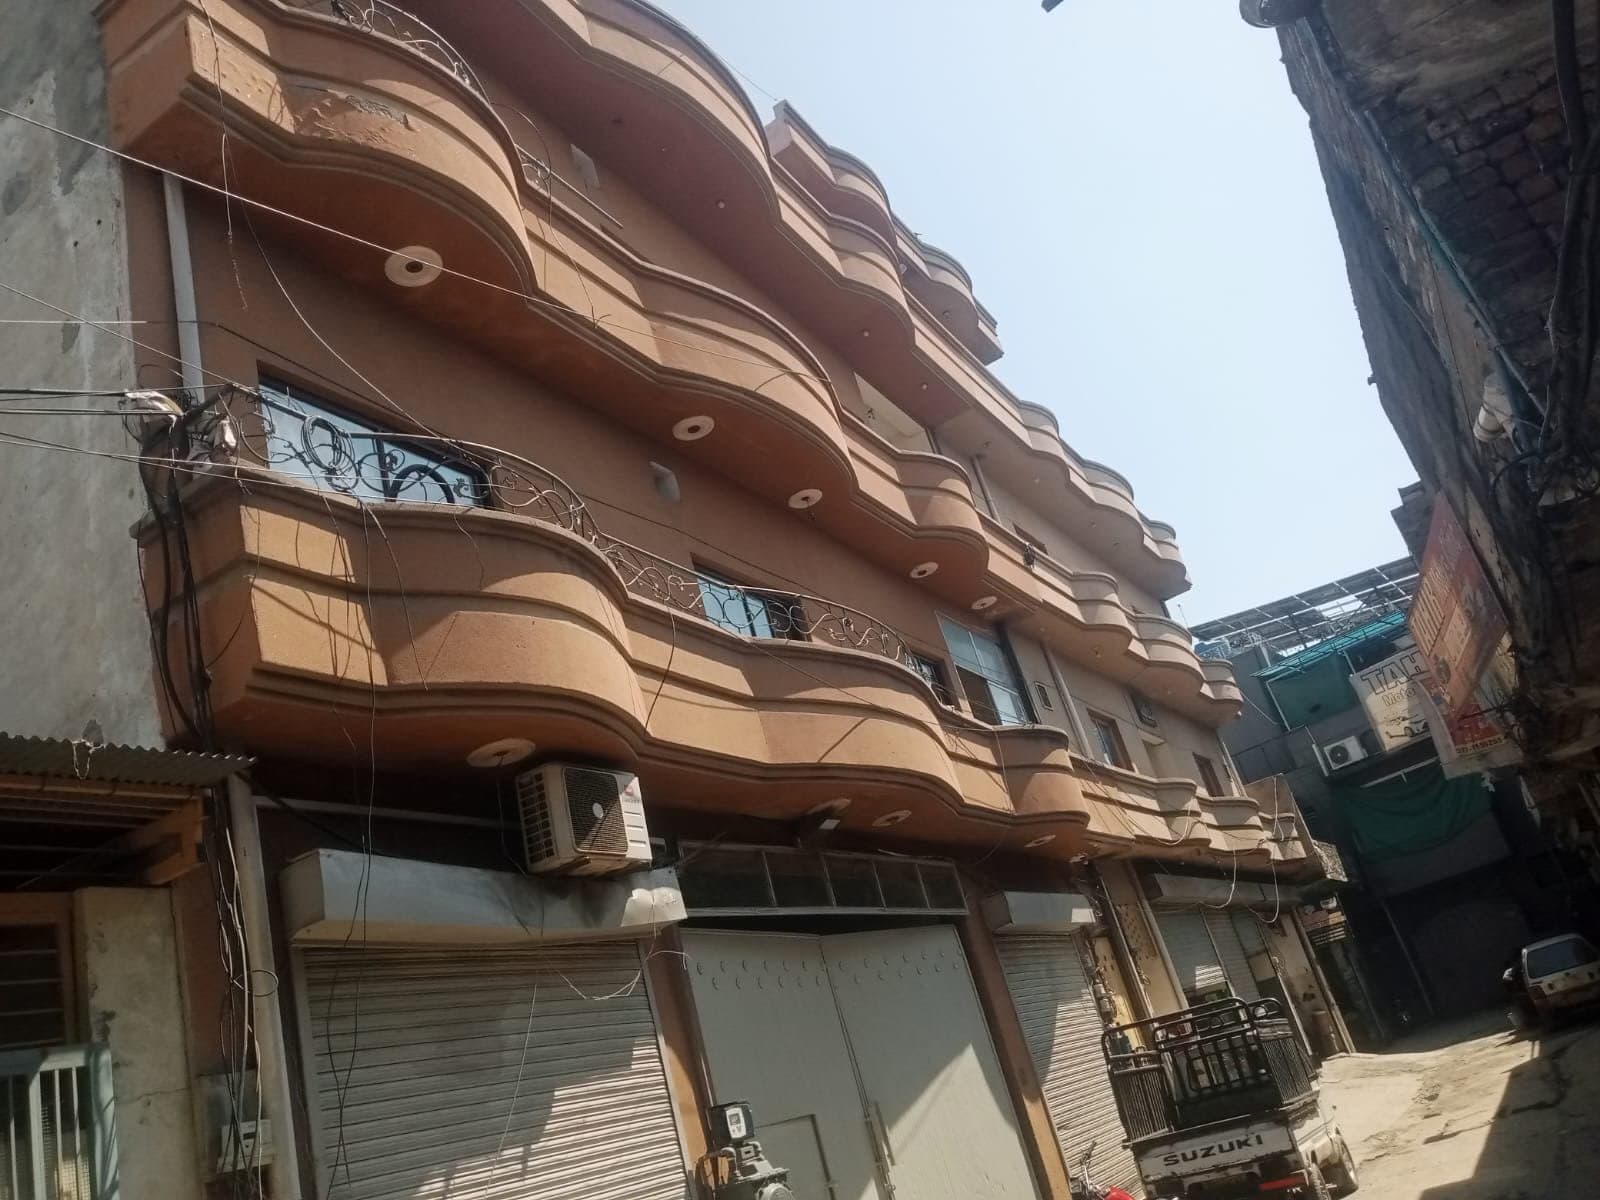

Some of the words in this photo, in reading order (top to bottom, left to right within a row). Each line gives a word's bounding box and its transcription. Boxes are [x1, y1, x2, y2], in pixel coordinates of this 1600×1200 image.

[1410, 576, 1445, 657] TAHIR
[1361, 650, 1429, 695] TAH
[1163, 1134, 1263, 1166] SUZUKI
